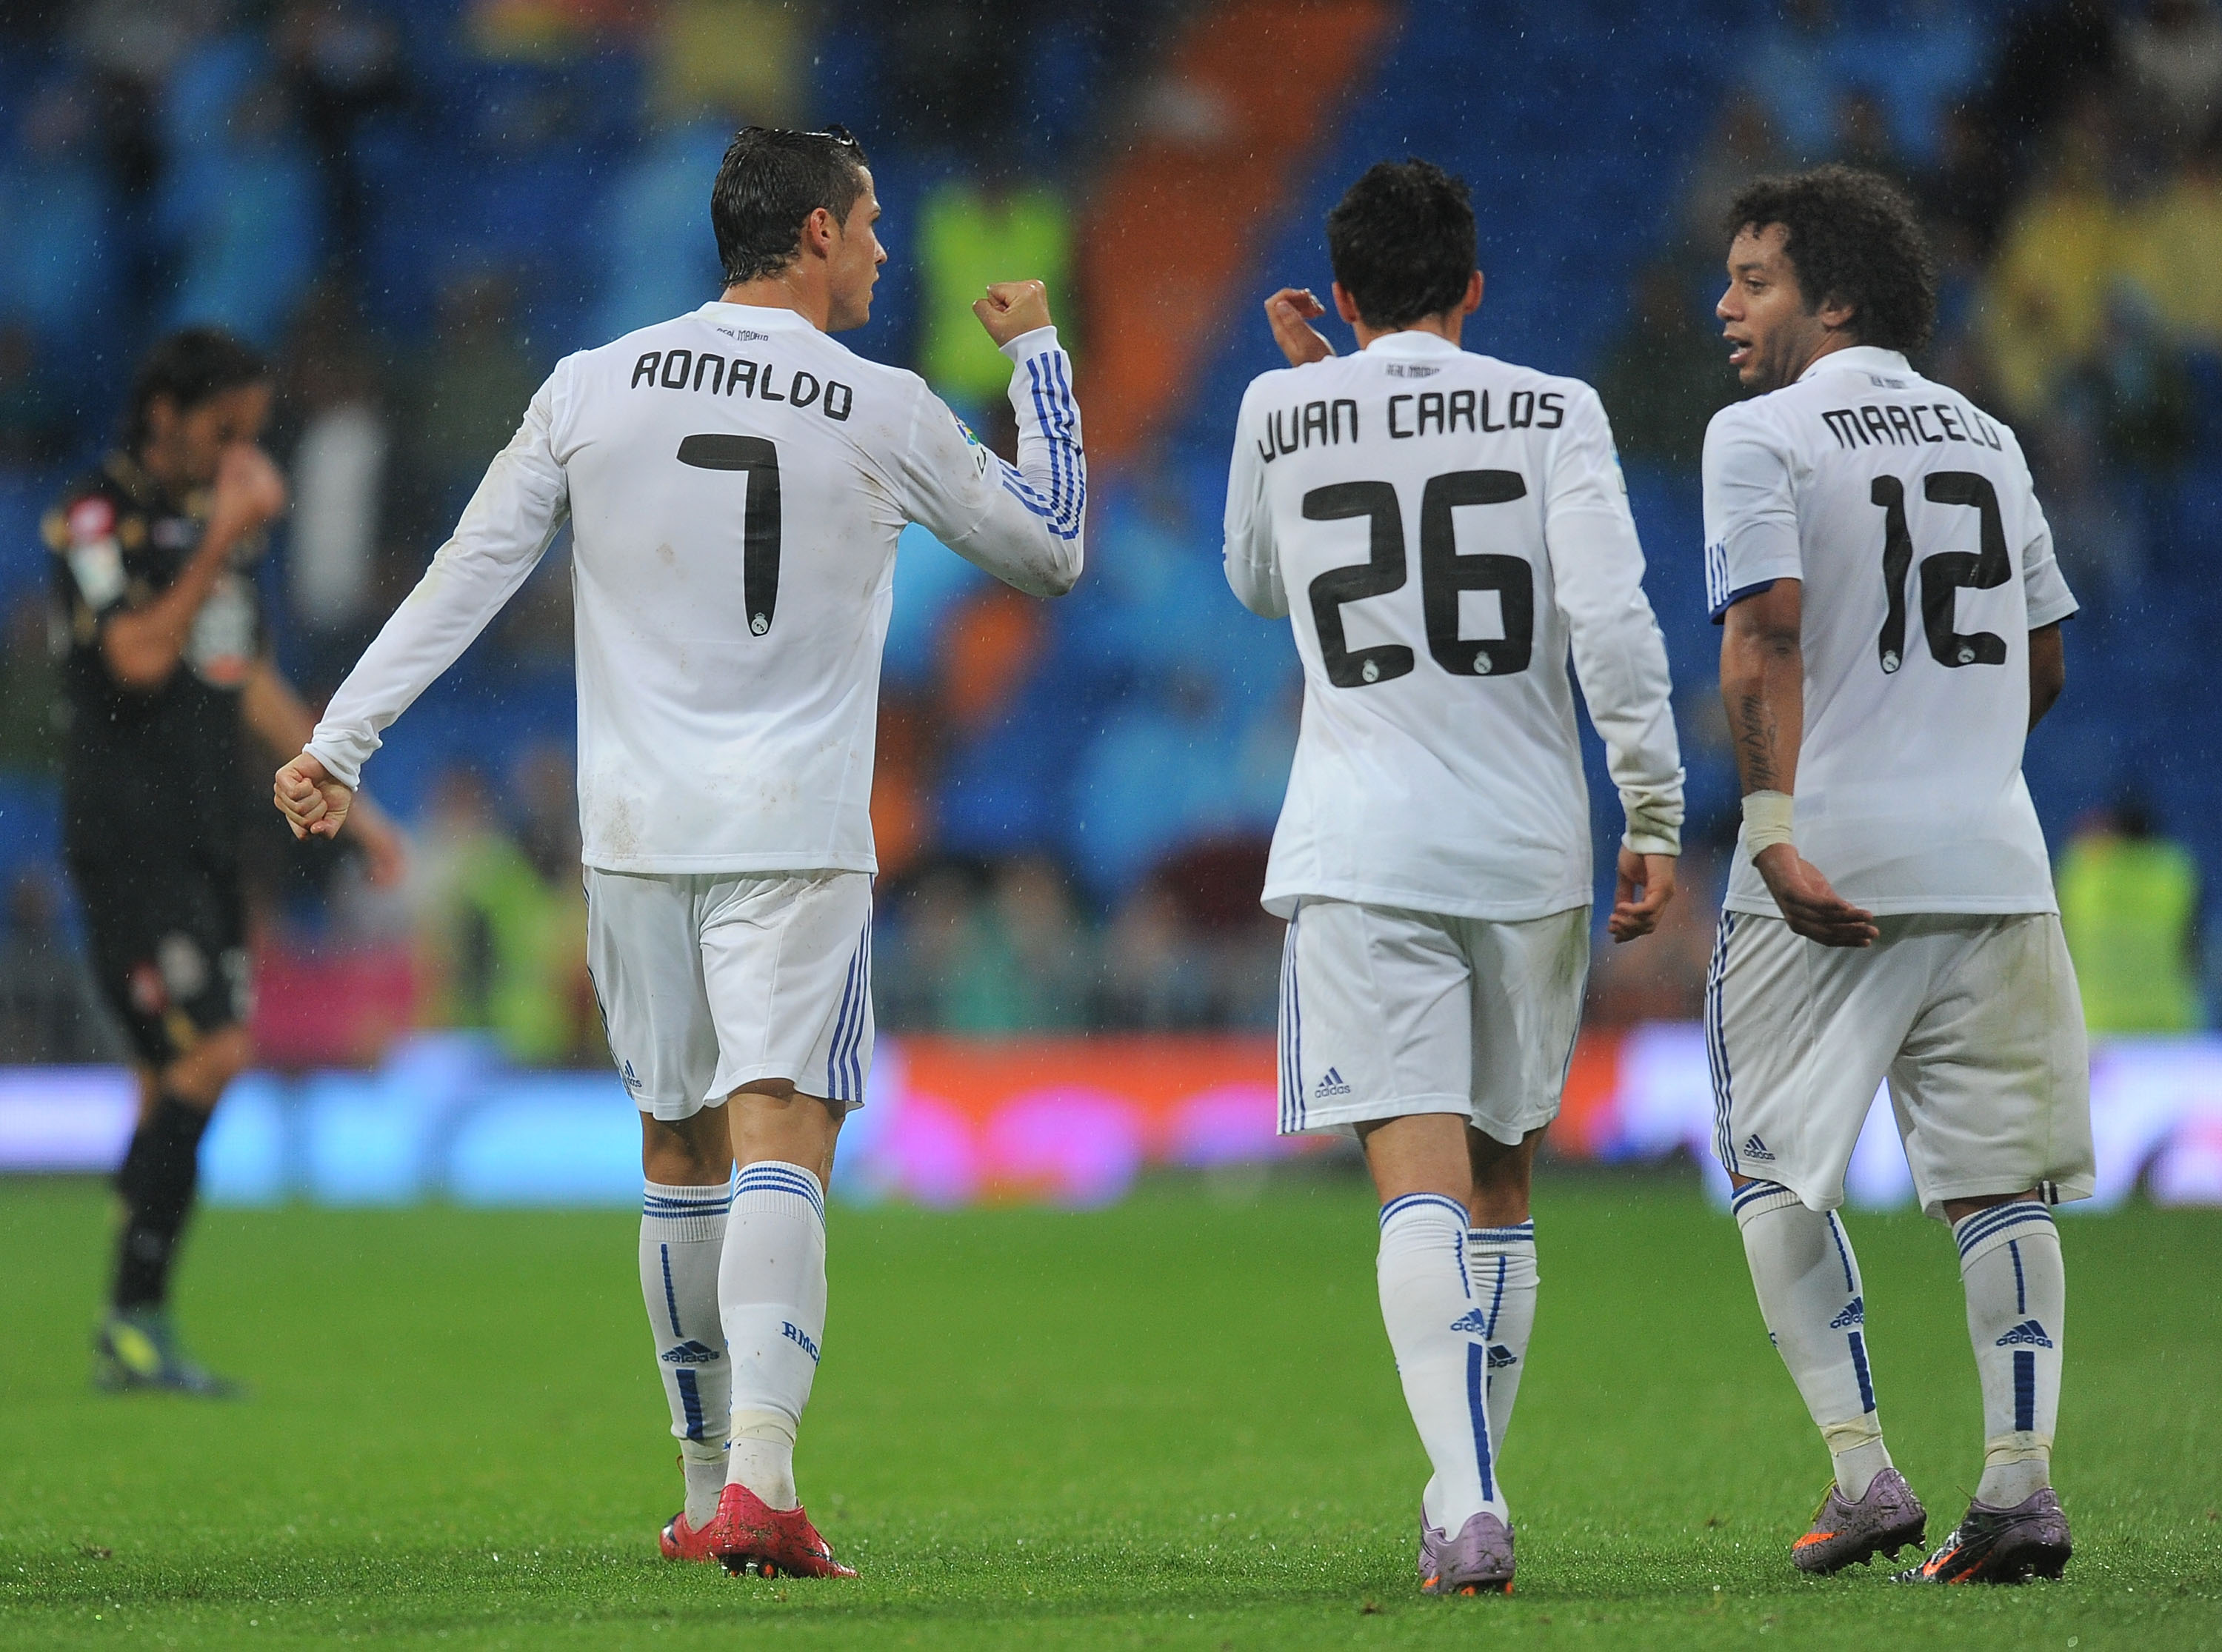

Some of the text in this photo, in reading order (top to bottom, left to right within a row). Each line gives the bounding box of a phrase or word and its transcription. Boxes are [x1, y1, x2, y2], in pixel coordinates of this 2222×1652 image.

[631, 349, 853, 423] RONALDO
[1258, 389, 1565, 464] JUAN CARLOS
[1821, 404, 2003, 452] MARCELO
[675, 432, 782, 638] 7
[1301, 469, 1535, 689] 26
[1870, 470, 2012, 675] 12
[1314, 1084, 1351, 1099] adidas
[1743, 1148, 1776, 1160] adidas
[781, 1320, 821, 1367] RMC
[1449, 1322, 1488, 1341] adida
[1830, 1314, 1864, 1329] adid
[1995, 1334, 2054, 1349] adidas
[661, 1349, 721, 1364] adidas
